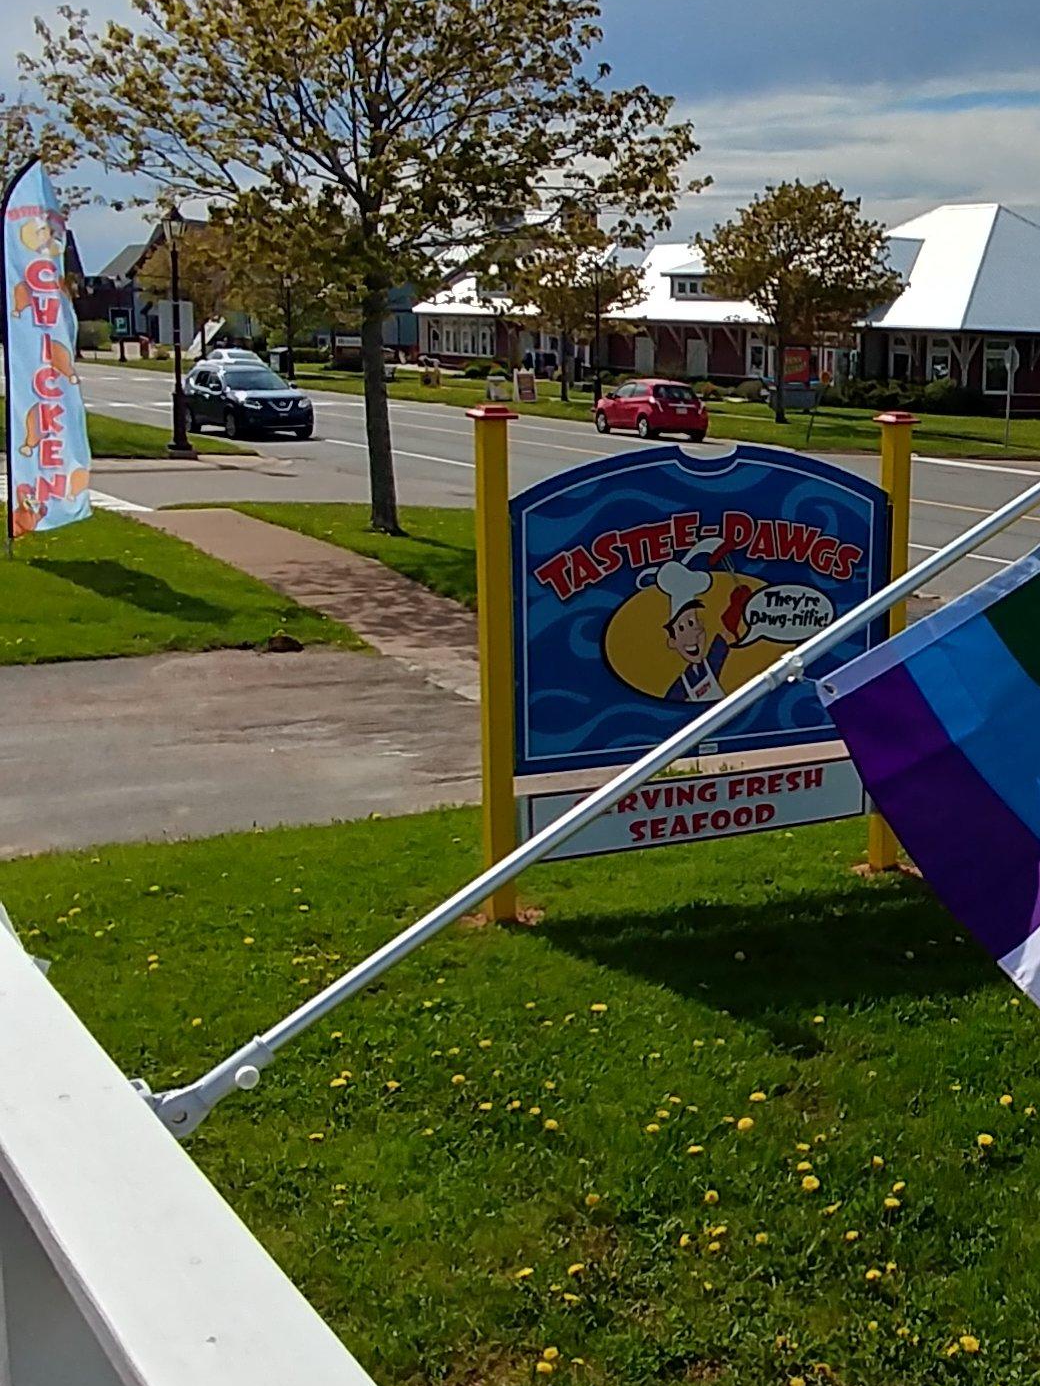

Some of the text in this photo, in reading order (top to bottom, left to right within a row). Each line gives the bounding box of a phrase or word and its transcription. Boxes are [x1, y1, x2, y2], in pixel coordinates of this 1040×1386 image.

[24, 259, 68, 503] CHICKEN
[534, 511, 862, 601] TASTEE-DAWGS
[763, 591, 820, 611] They're
[573, 767, 824, 815] RVING FRESH
[629, 803, 776, 843] SEAFOOD
